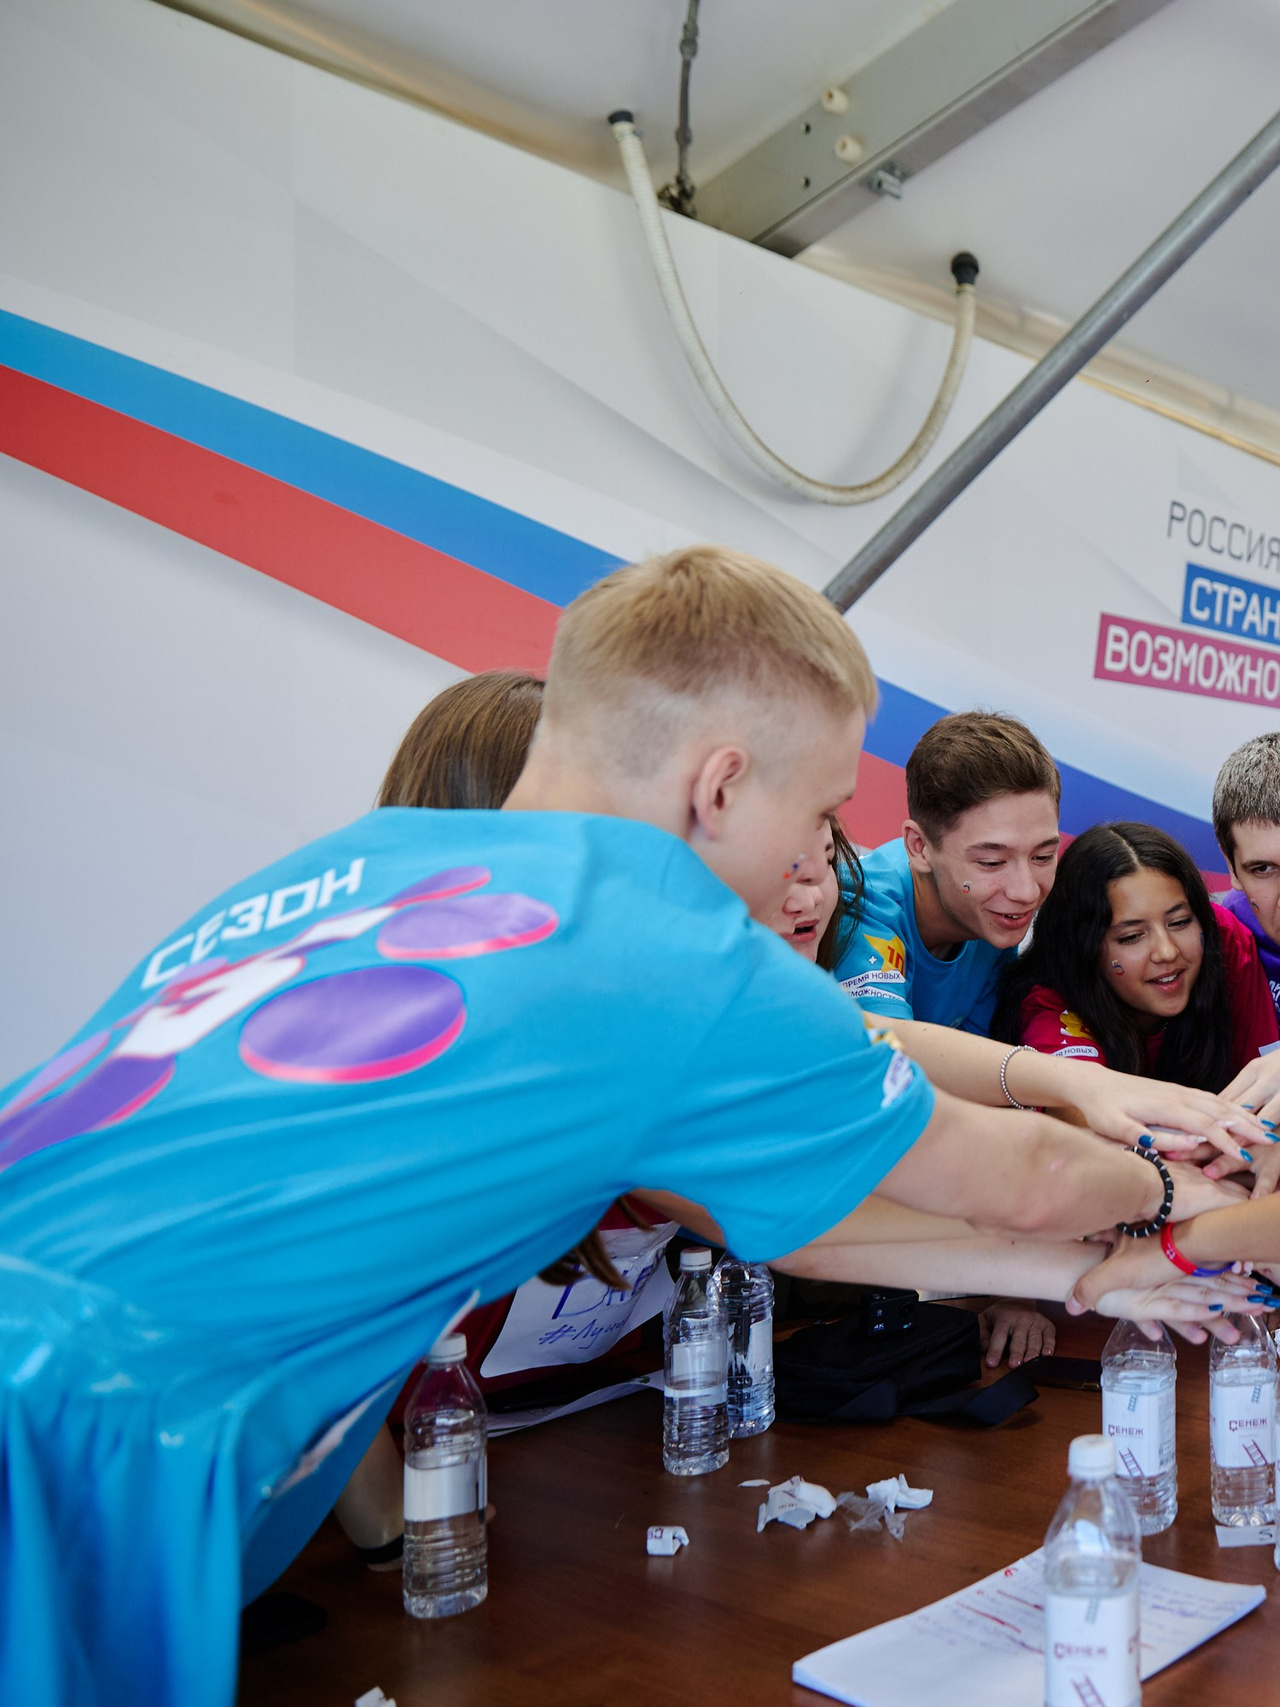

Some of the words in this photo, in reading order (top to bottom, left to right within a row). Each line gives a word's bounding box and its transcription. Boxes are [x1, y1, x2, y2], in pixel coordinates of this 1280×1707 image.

[141, 858, 365, 989] СЕЗОН
[871, 972, 901, 980] НОВЫХ
[1108, 1424, 1144, 1437] СЕНЕЖ
[1229, 1417, 1267, 1432] СЕНЕЖ
